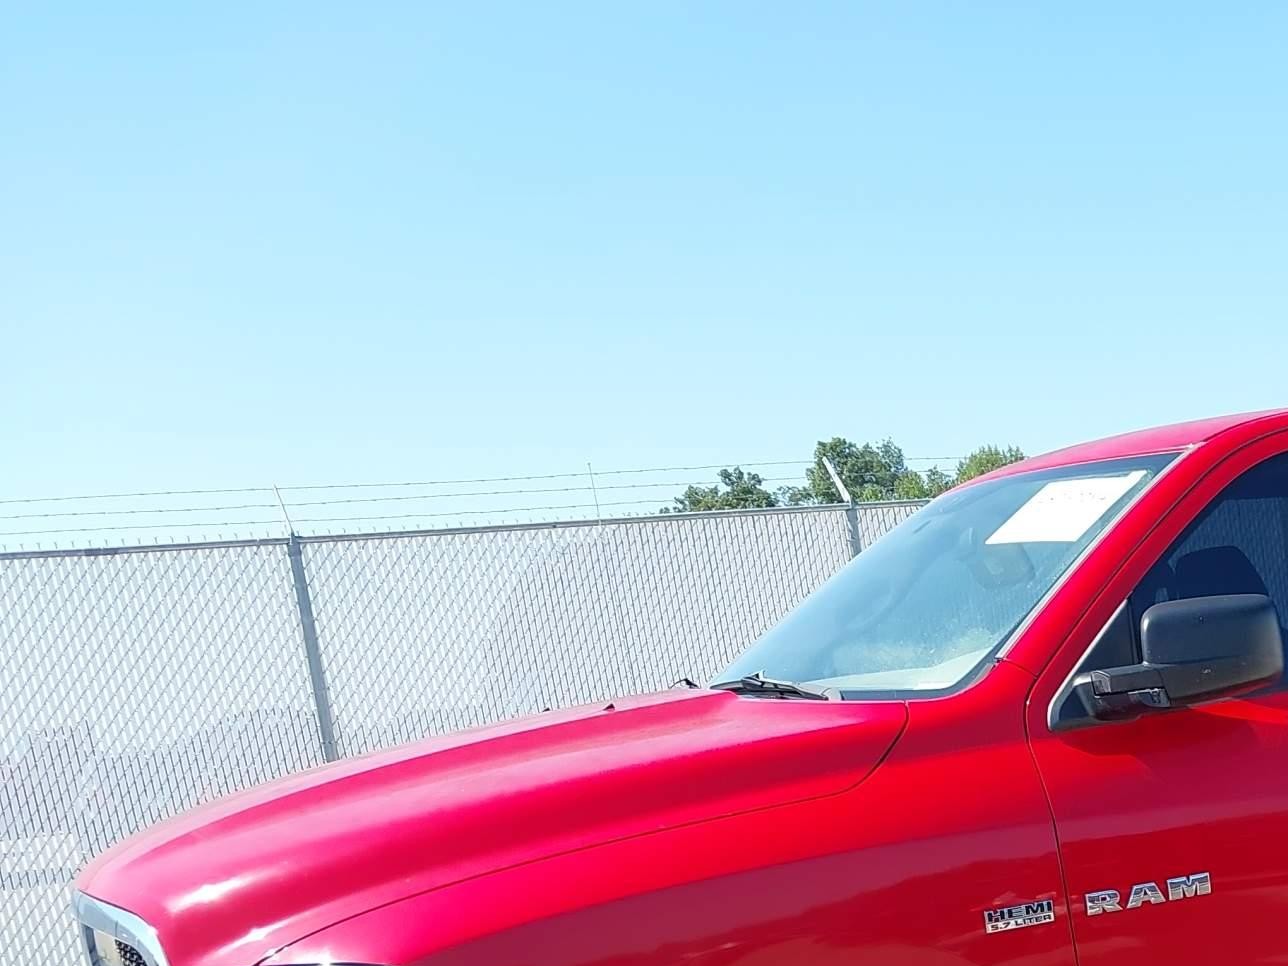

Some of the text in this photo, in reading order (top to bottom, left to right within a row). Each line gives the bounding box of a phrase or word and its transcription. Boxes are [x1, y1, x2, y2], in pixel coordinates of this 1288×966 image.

[1085, 872, 1211, 916] RAM
[986, 900, 1054, 924] HEMI
[990, 913, 1053, 932] 5.7 LITER
